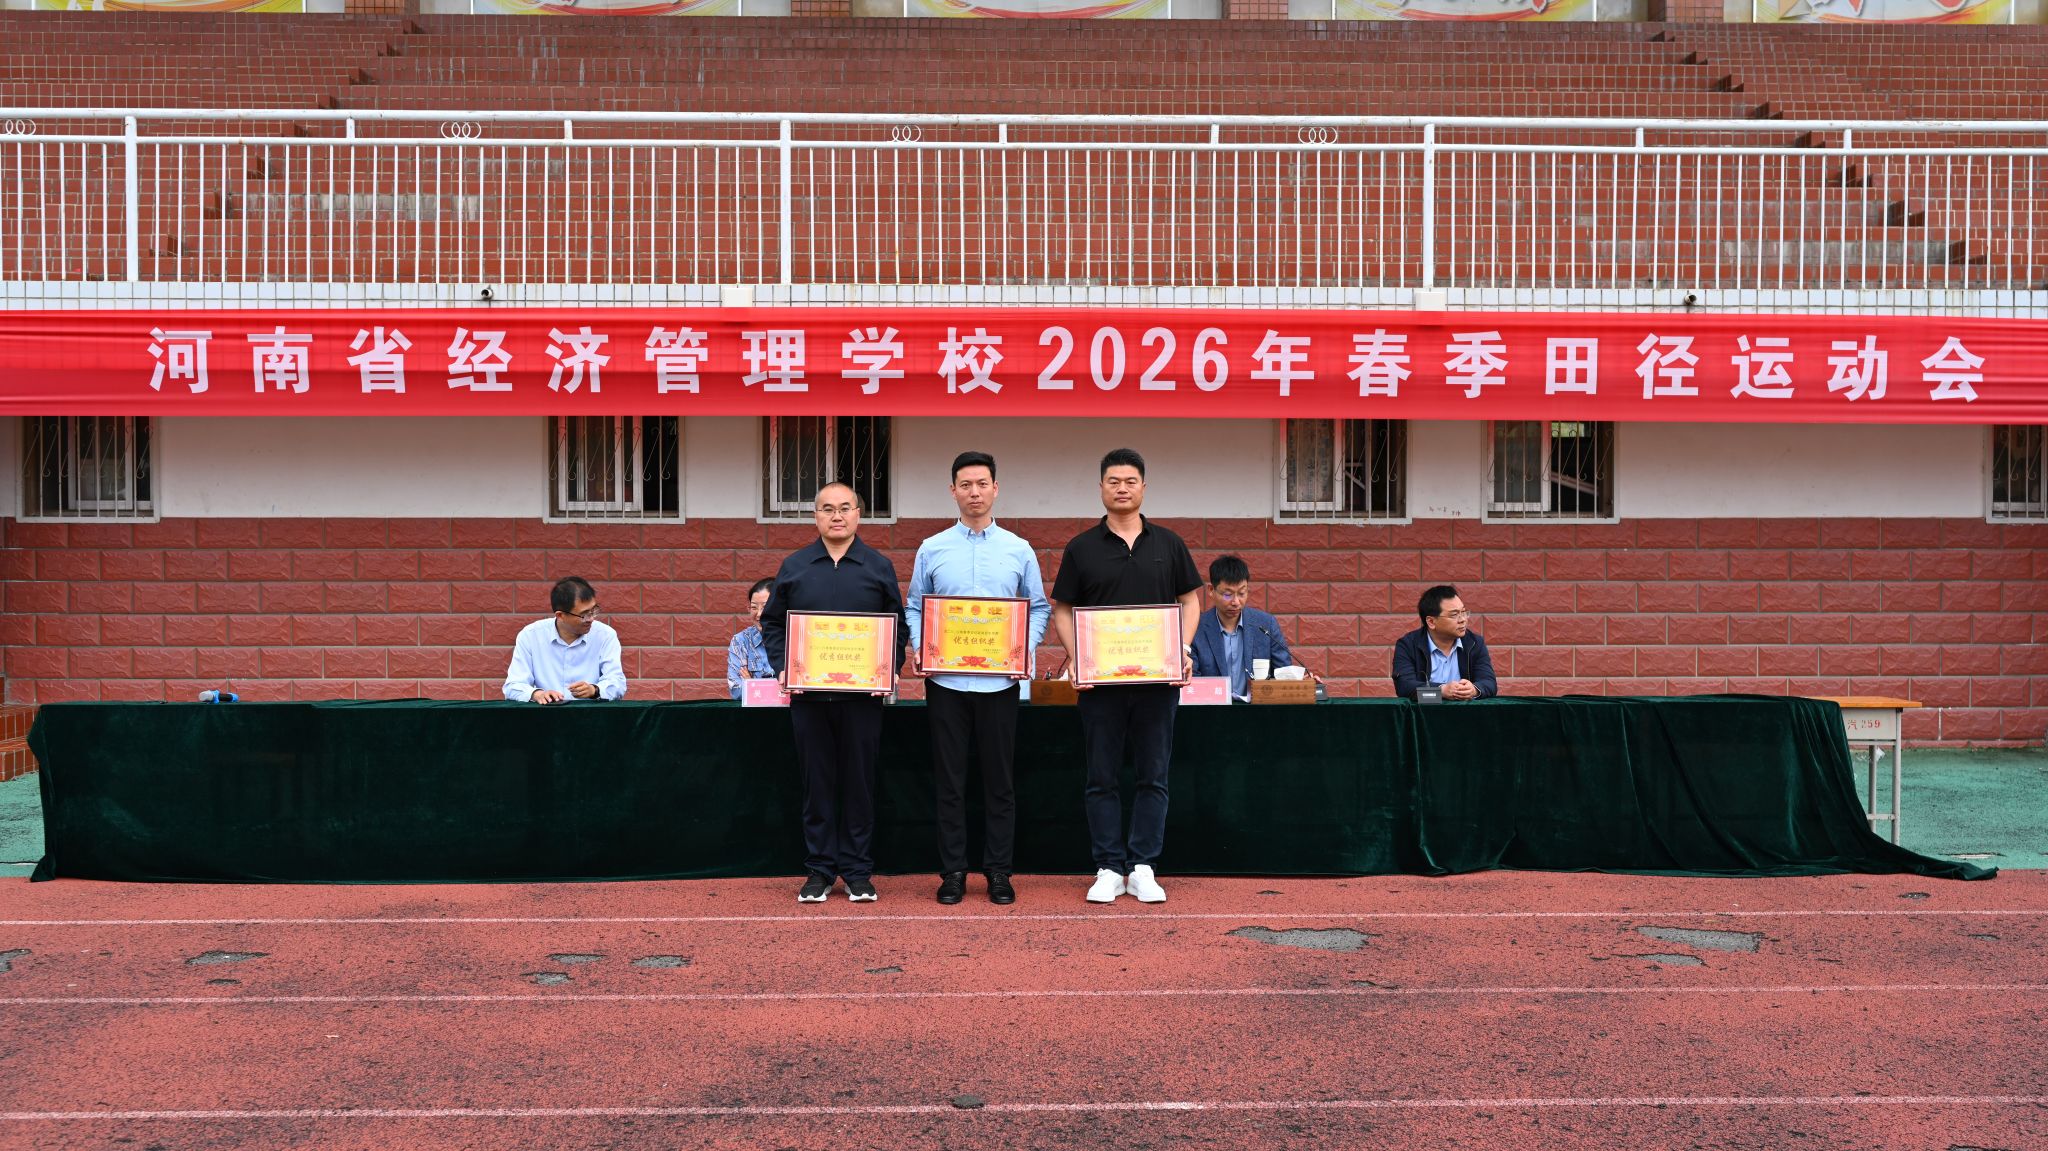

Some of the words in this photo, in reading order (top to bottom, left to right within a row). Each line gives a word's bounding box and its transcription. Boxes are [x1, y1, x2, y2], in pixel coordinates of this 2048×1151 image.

[147, 324, 1986, 402] 河南省经济管理学校2026年春季田径运动会
